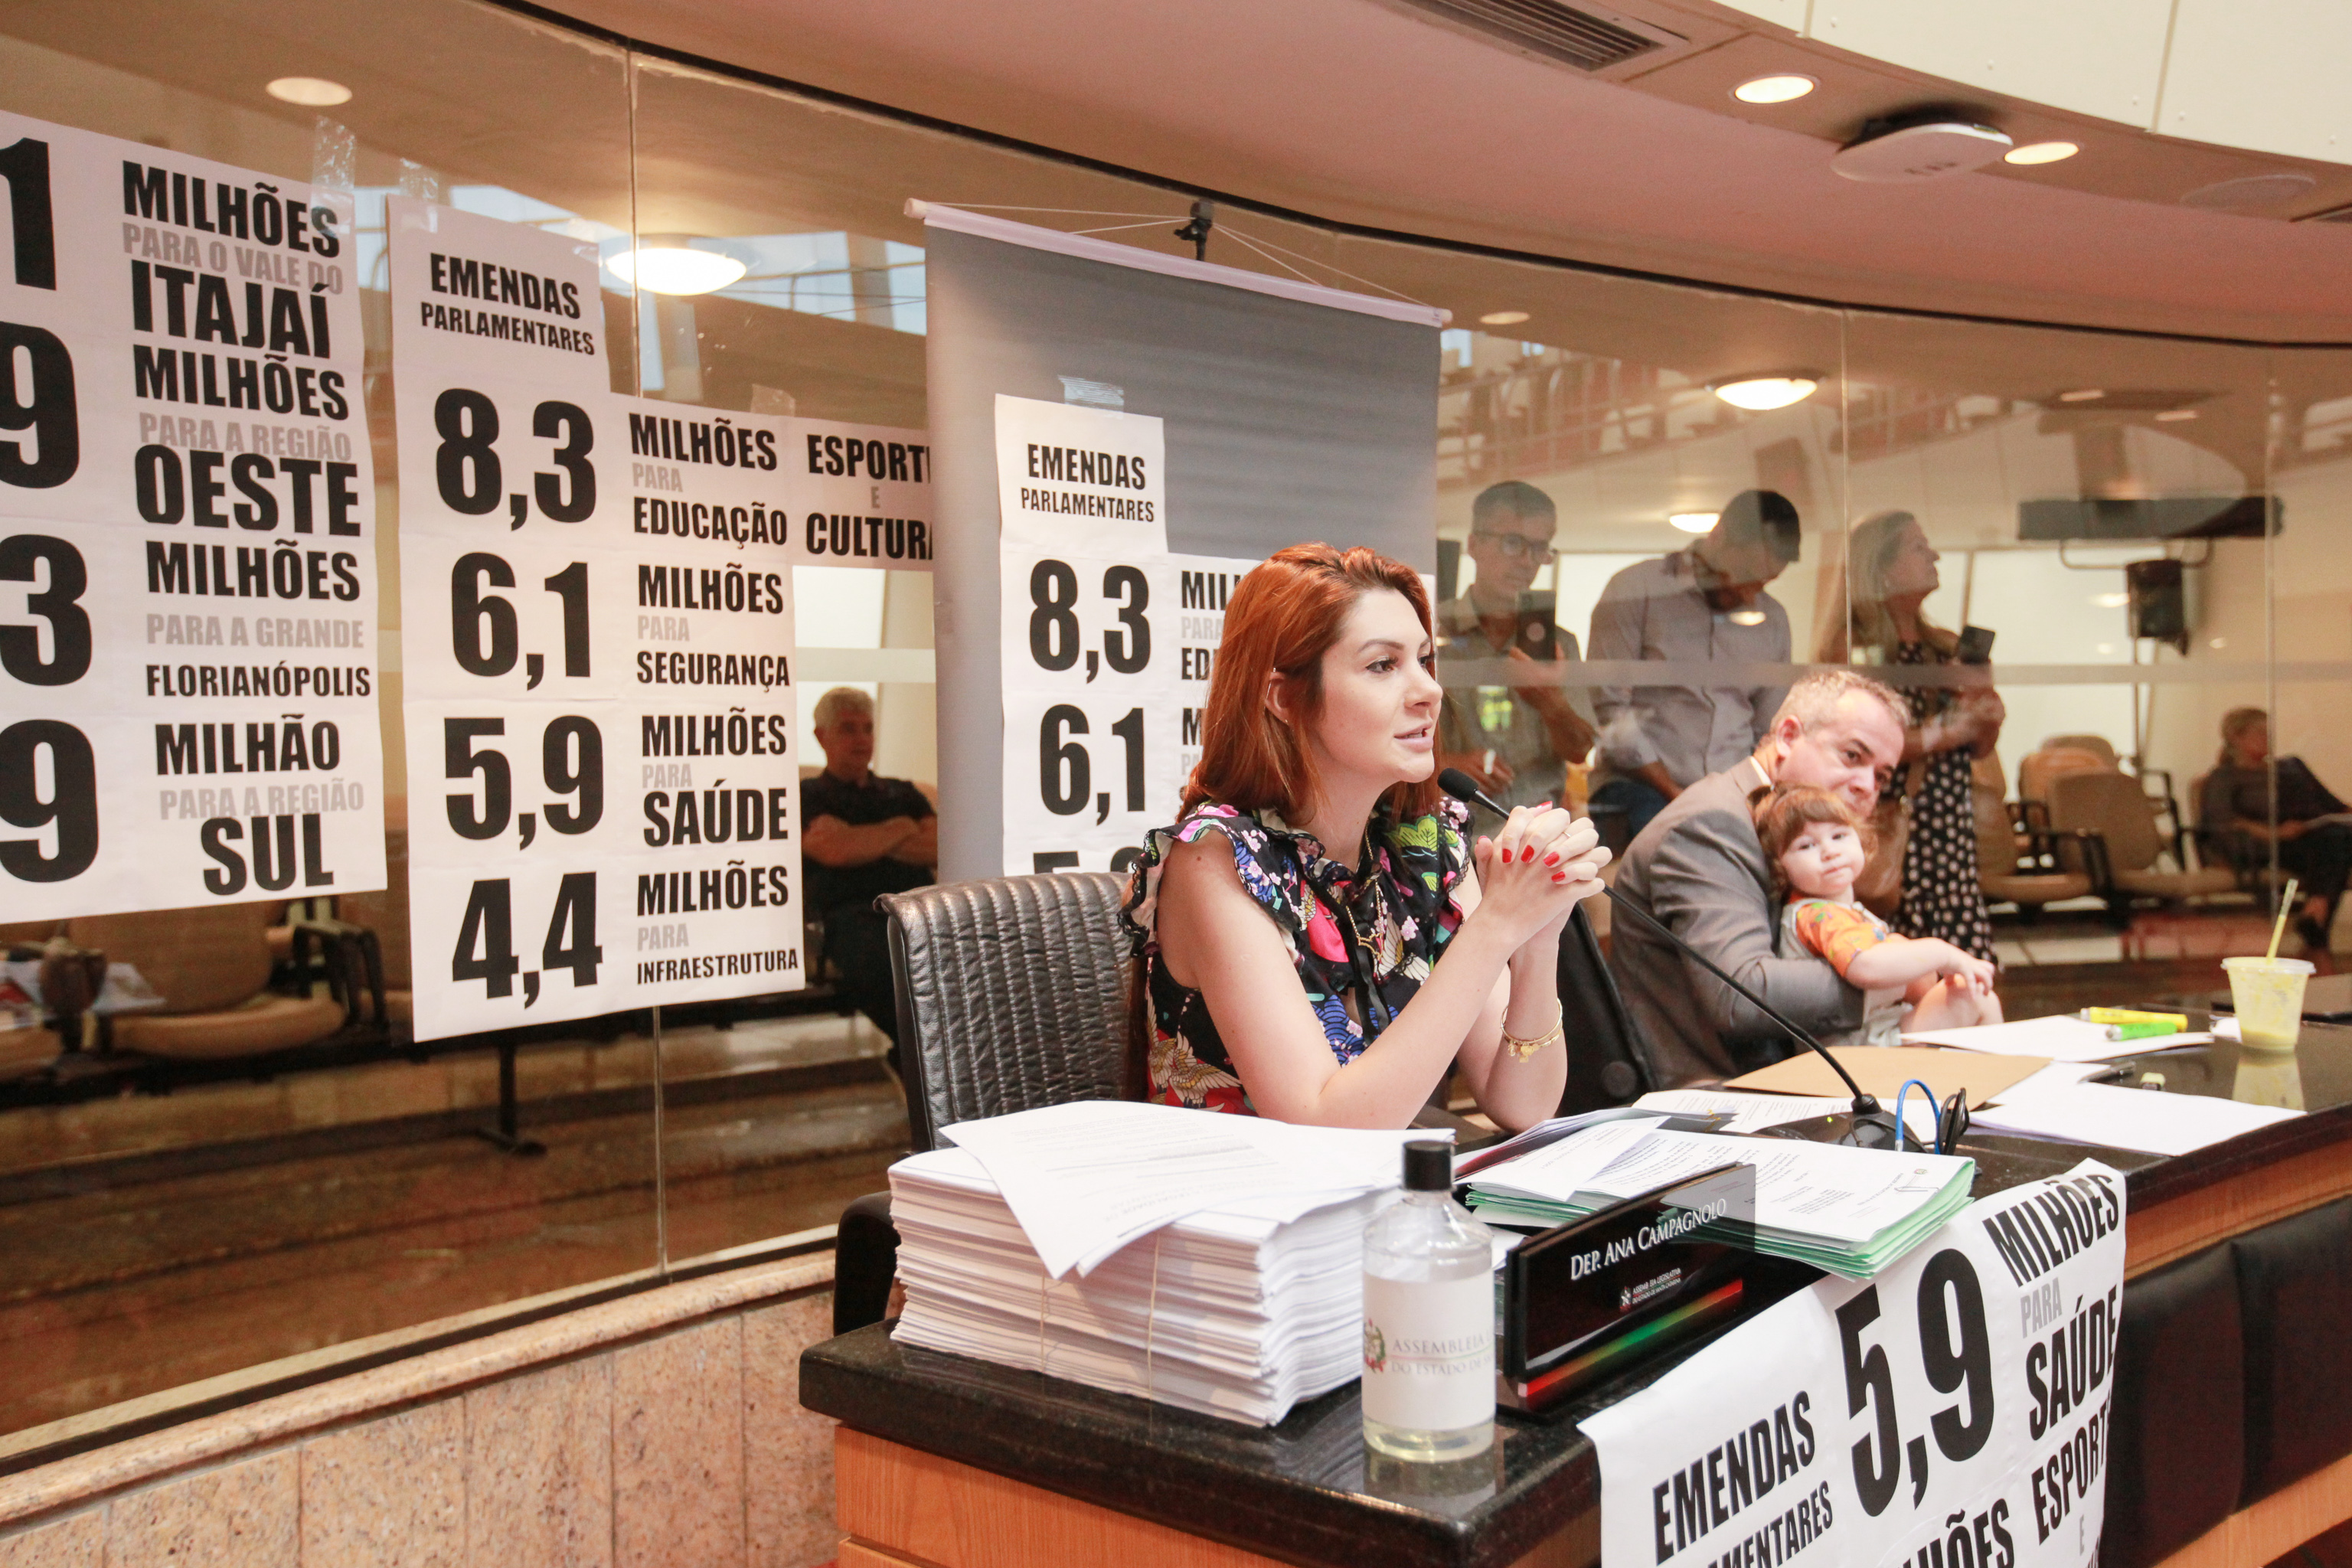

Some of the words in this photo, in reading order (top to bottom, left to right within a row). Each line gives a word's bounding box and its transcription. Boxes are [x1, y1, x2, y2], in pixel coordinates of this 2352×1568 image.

[122, 160, 340, 258] MILHÕES
[122, 222, 202, 268] PARA
[209, 240, 228, 273] O
[234, 246, 301, 287] VALE
[308, 260, 343, 295] DO
[430, 252, 581, 320] EMENDAS
[131, 259, 332, 359] ITAJAÍ
[420, 301, 595, 356] PARLAMENTARES
[132, 344, 349, 421] MILHÕES
[139, 412, 219, 450] PARA
[225, 422, 246, 452] A
[251, 425, 352, 462] REGIÃO
[434, 387, 596, 531] 8,3
[628, 413, 778, 472] MILHÕES
[807, 434, 931, 484] ESPORT
[1027, 443, 1145, 491] EMENDAS
[135, 444, 361, 537] OESTE
[632, 462, 684, 492] PARA
[871, 486, 880, 508] E
[1021, 487, 1154, 523] PARLAMENTARES
[633, 496, 788, 549] EDUCAÇÃO
[145, 538, 361, 602] MILHÕES
[638, 562, 784, 615] MILHÕES
[147, 613, 224, 646] PARA
[230, 617, 249, 646] A
[256, 618, 364, 648] GRANDE
[451, 552, 591, 691] 6,1
[637, 615, 690, 642] PARA
[1029, 559, 1150, 684] 8,3
[145, 660, 371, 697] FLORIANÓPOLIS
[636, 651, 790, 693] SEGURANÇA
[155, 713, 341, 776] MILHÃO
[642, 707, 786, 757] MILHÕES
[444, 714, 603, 851] 5,9
[642, 763, 692, 789] PARA
[1039, 704, 1145, 827] 6,1
[159, 788, 237, 821] PARA
[243, 787, 261, 816] A
[267, 778, 364, 815] REGIÃO
[643, 779, 789, 848] SAÚDE
[201, 812, 335, 896] SUL
[637, 859, 789, 916] MILHÕES
[452, 871, 603, 1010] 4,4
[637, 923, 689, 952] PARA
[637, 949, 798, 985] INFRAESTRUTURA
[1982, 1174, 2118, 1288] MILHÕES
[2020, 1277, 2062, 1339] PARA
[1393, 1333, 1484, 1354] ASSEMBLEIA
[1834, 1247, 1994, 1517] 5,9
[1652, 1390, 1815, 1566] EMENDAS
[2031, 1398, 2110, 1546] ESPORT
